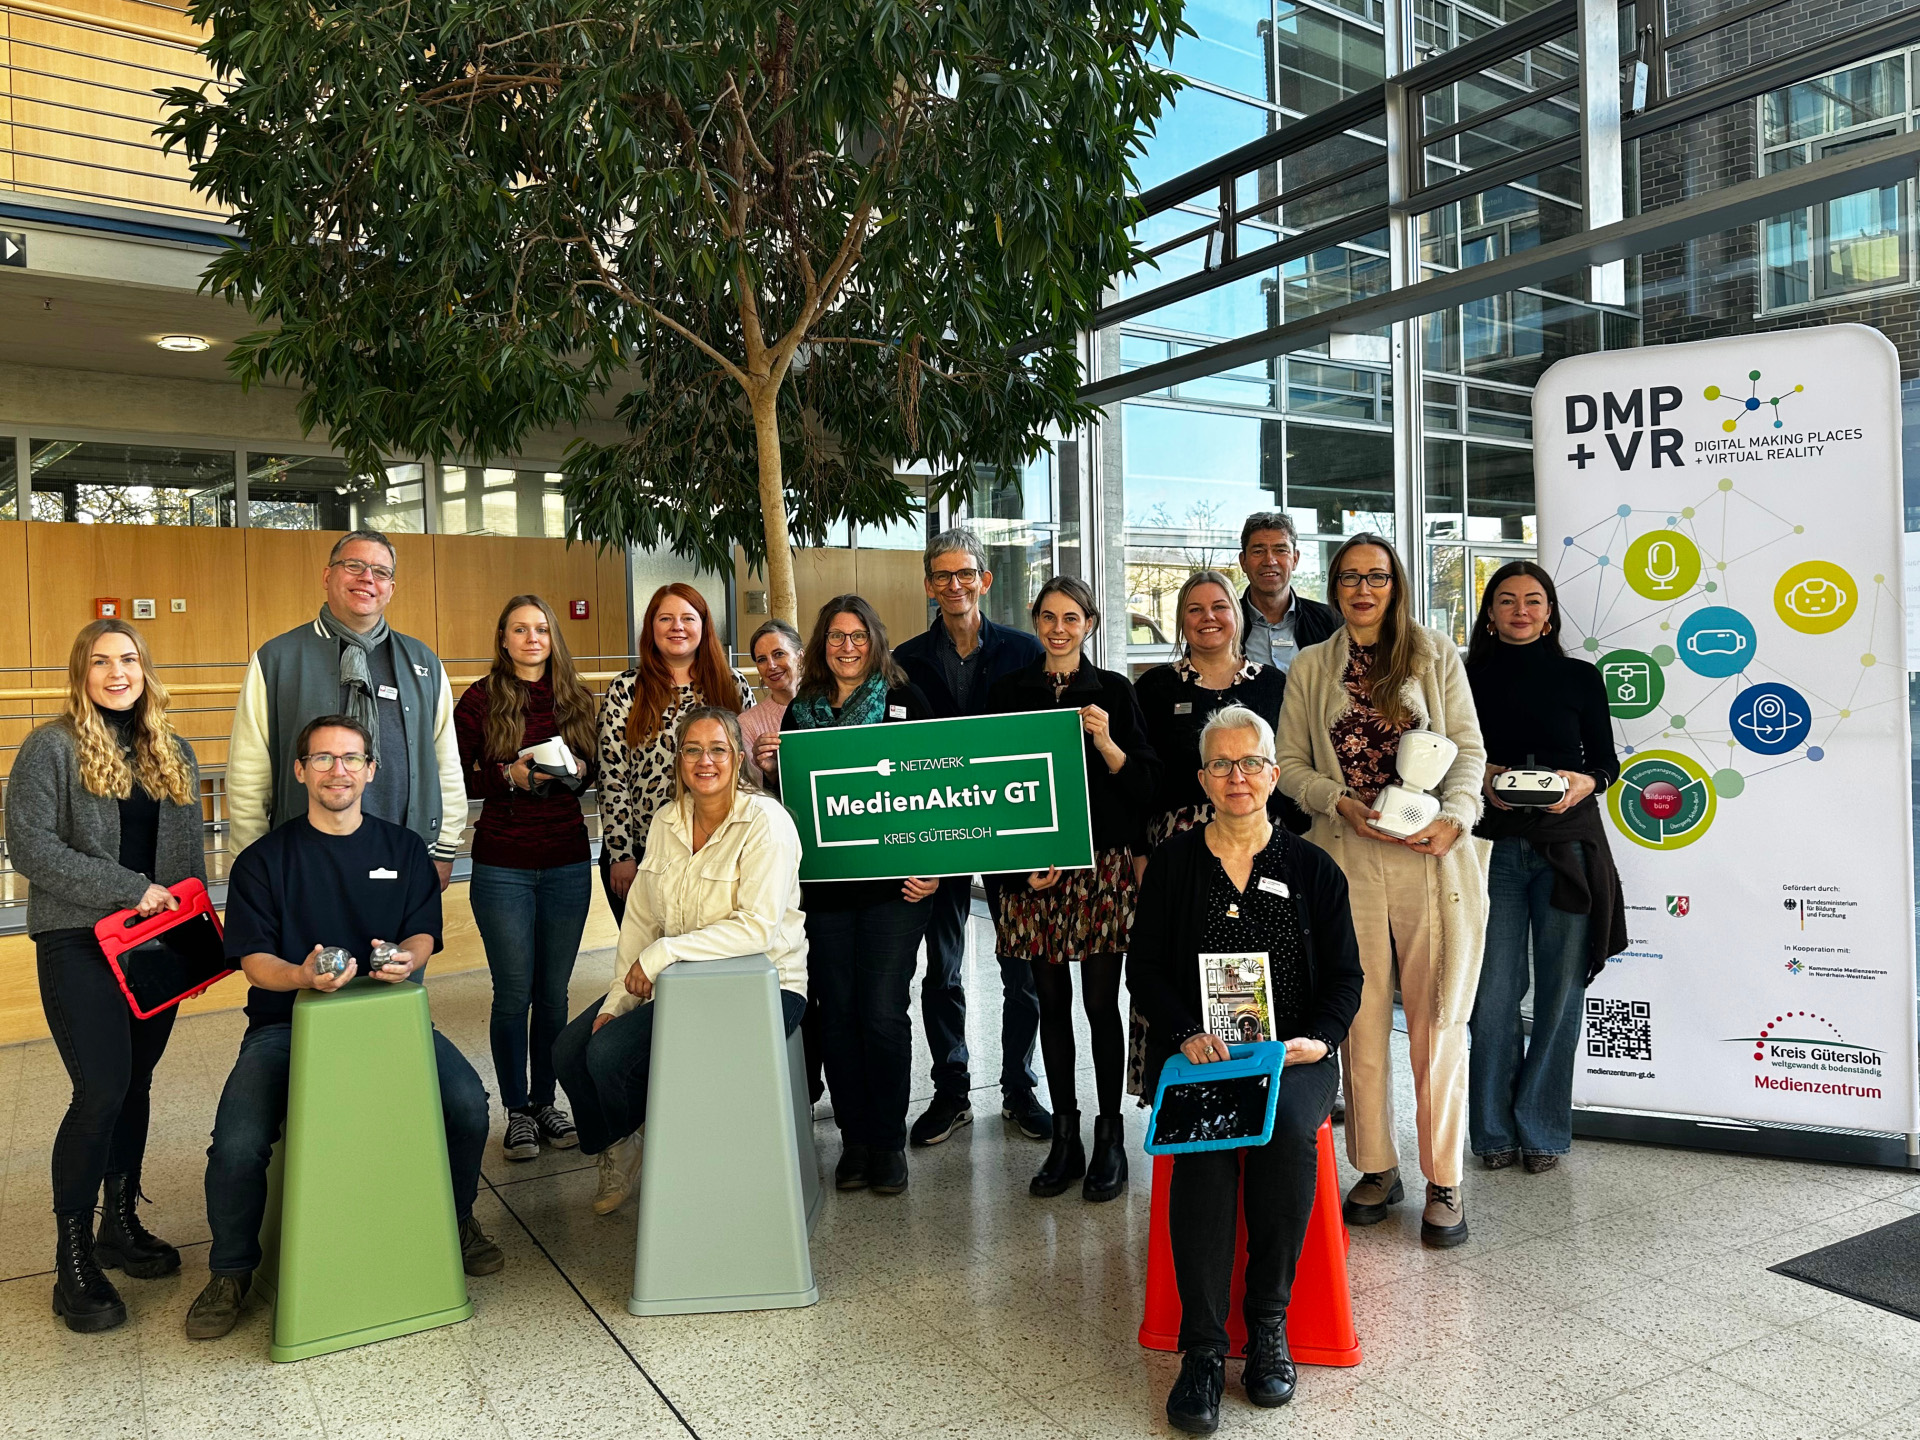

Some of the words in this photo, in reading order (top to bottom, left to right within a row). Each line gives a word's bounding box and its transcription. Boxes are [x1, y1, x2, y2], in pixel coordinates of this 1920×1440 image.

[1566, 386, 1683, 434] DMP
[1695, 438, 1745, 452] DIGITAL
[1750, 434, 1803, 448] MAKING
[1808, 429, 1862, 443] PLACES
[1706, 451, 1763, 464] VIRTUAL
[1767, 445, 1824, 460] REALITY
[900, 756, 964, 772] NETZWERK
[1508, 776, 1516, 787] 2
[1632, 767, 1683, 781] Bildungsmanagement
[826, 785, 997, 816] MedienAktiv
[1004, 781, 1040, 803] GT
[884, 832, 916, 845] KREIS
[918, 827, 992, 843] GÜTERSLOH
[1210, 1003, 1229, 1015] ORT
[1212, 1016, 1231, 1028] DER
[1771, 1045, 1806, 1059] Kreis
[1811, 1048, 1881, 1065] Gütersloh
[1587, 1068, 1655, 1079] medienzentrum-gt.de
[1772, 1060, 1819, 1070] weltgewandt
[1828, 1064, 1882, 1077] bodenständig
[1755, 1075, 1882, 1099] Medienzentrum
